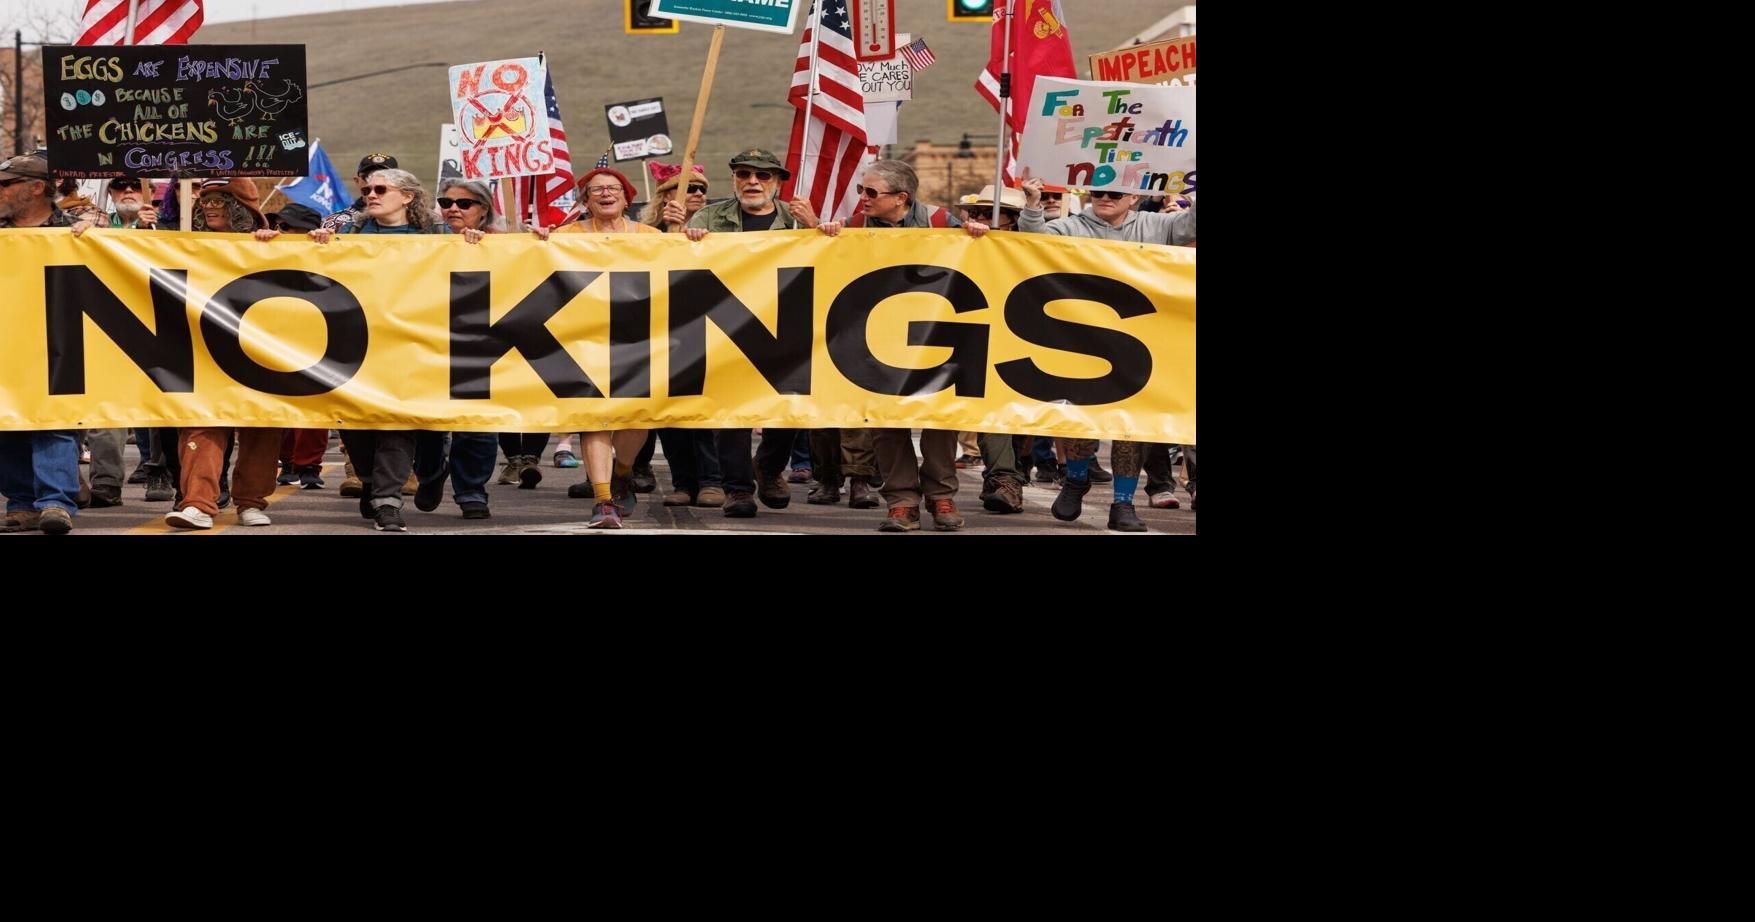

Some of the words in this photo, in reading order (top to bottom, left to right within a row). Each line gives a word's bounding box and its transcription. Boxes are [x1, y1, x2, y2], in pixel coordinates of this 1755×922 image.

[61, 55, 124, 82] EGGS
[132, 60, 165, 78] ARE
[175, 56, 279, 82] EXPENSIVE
[1098, 42, 1196, 81] IMPEACH
[458, 64, 527, 98] NO
[872, 71, 909, 82] CARES
[887, 80, 911, 91] YOU
[115, 88, 184, 104] BECAUSE
[1103, 90, 1143, 115] The
[134, 104, 163, 121] ALL
[168, 104, 189, 119] OF
[57, 124, 94, 141] THE
[98, 117, 218, 145] CHICKENS
[232, 125, 272, 140] ARE
[125, 147, 235, 170] CONGRESS
[463, 141, 554, 179] KINGS
[1094, 143, 1143, 163] Time
[44, 264, 369, 397] NO
[449, 263, 1157, 406] KINGS
